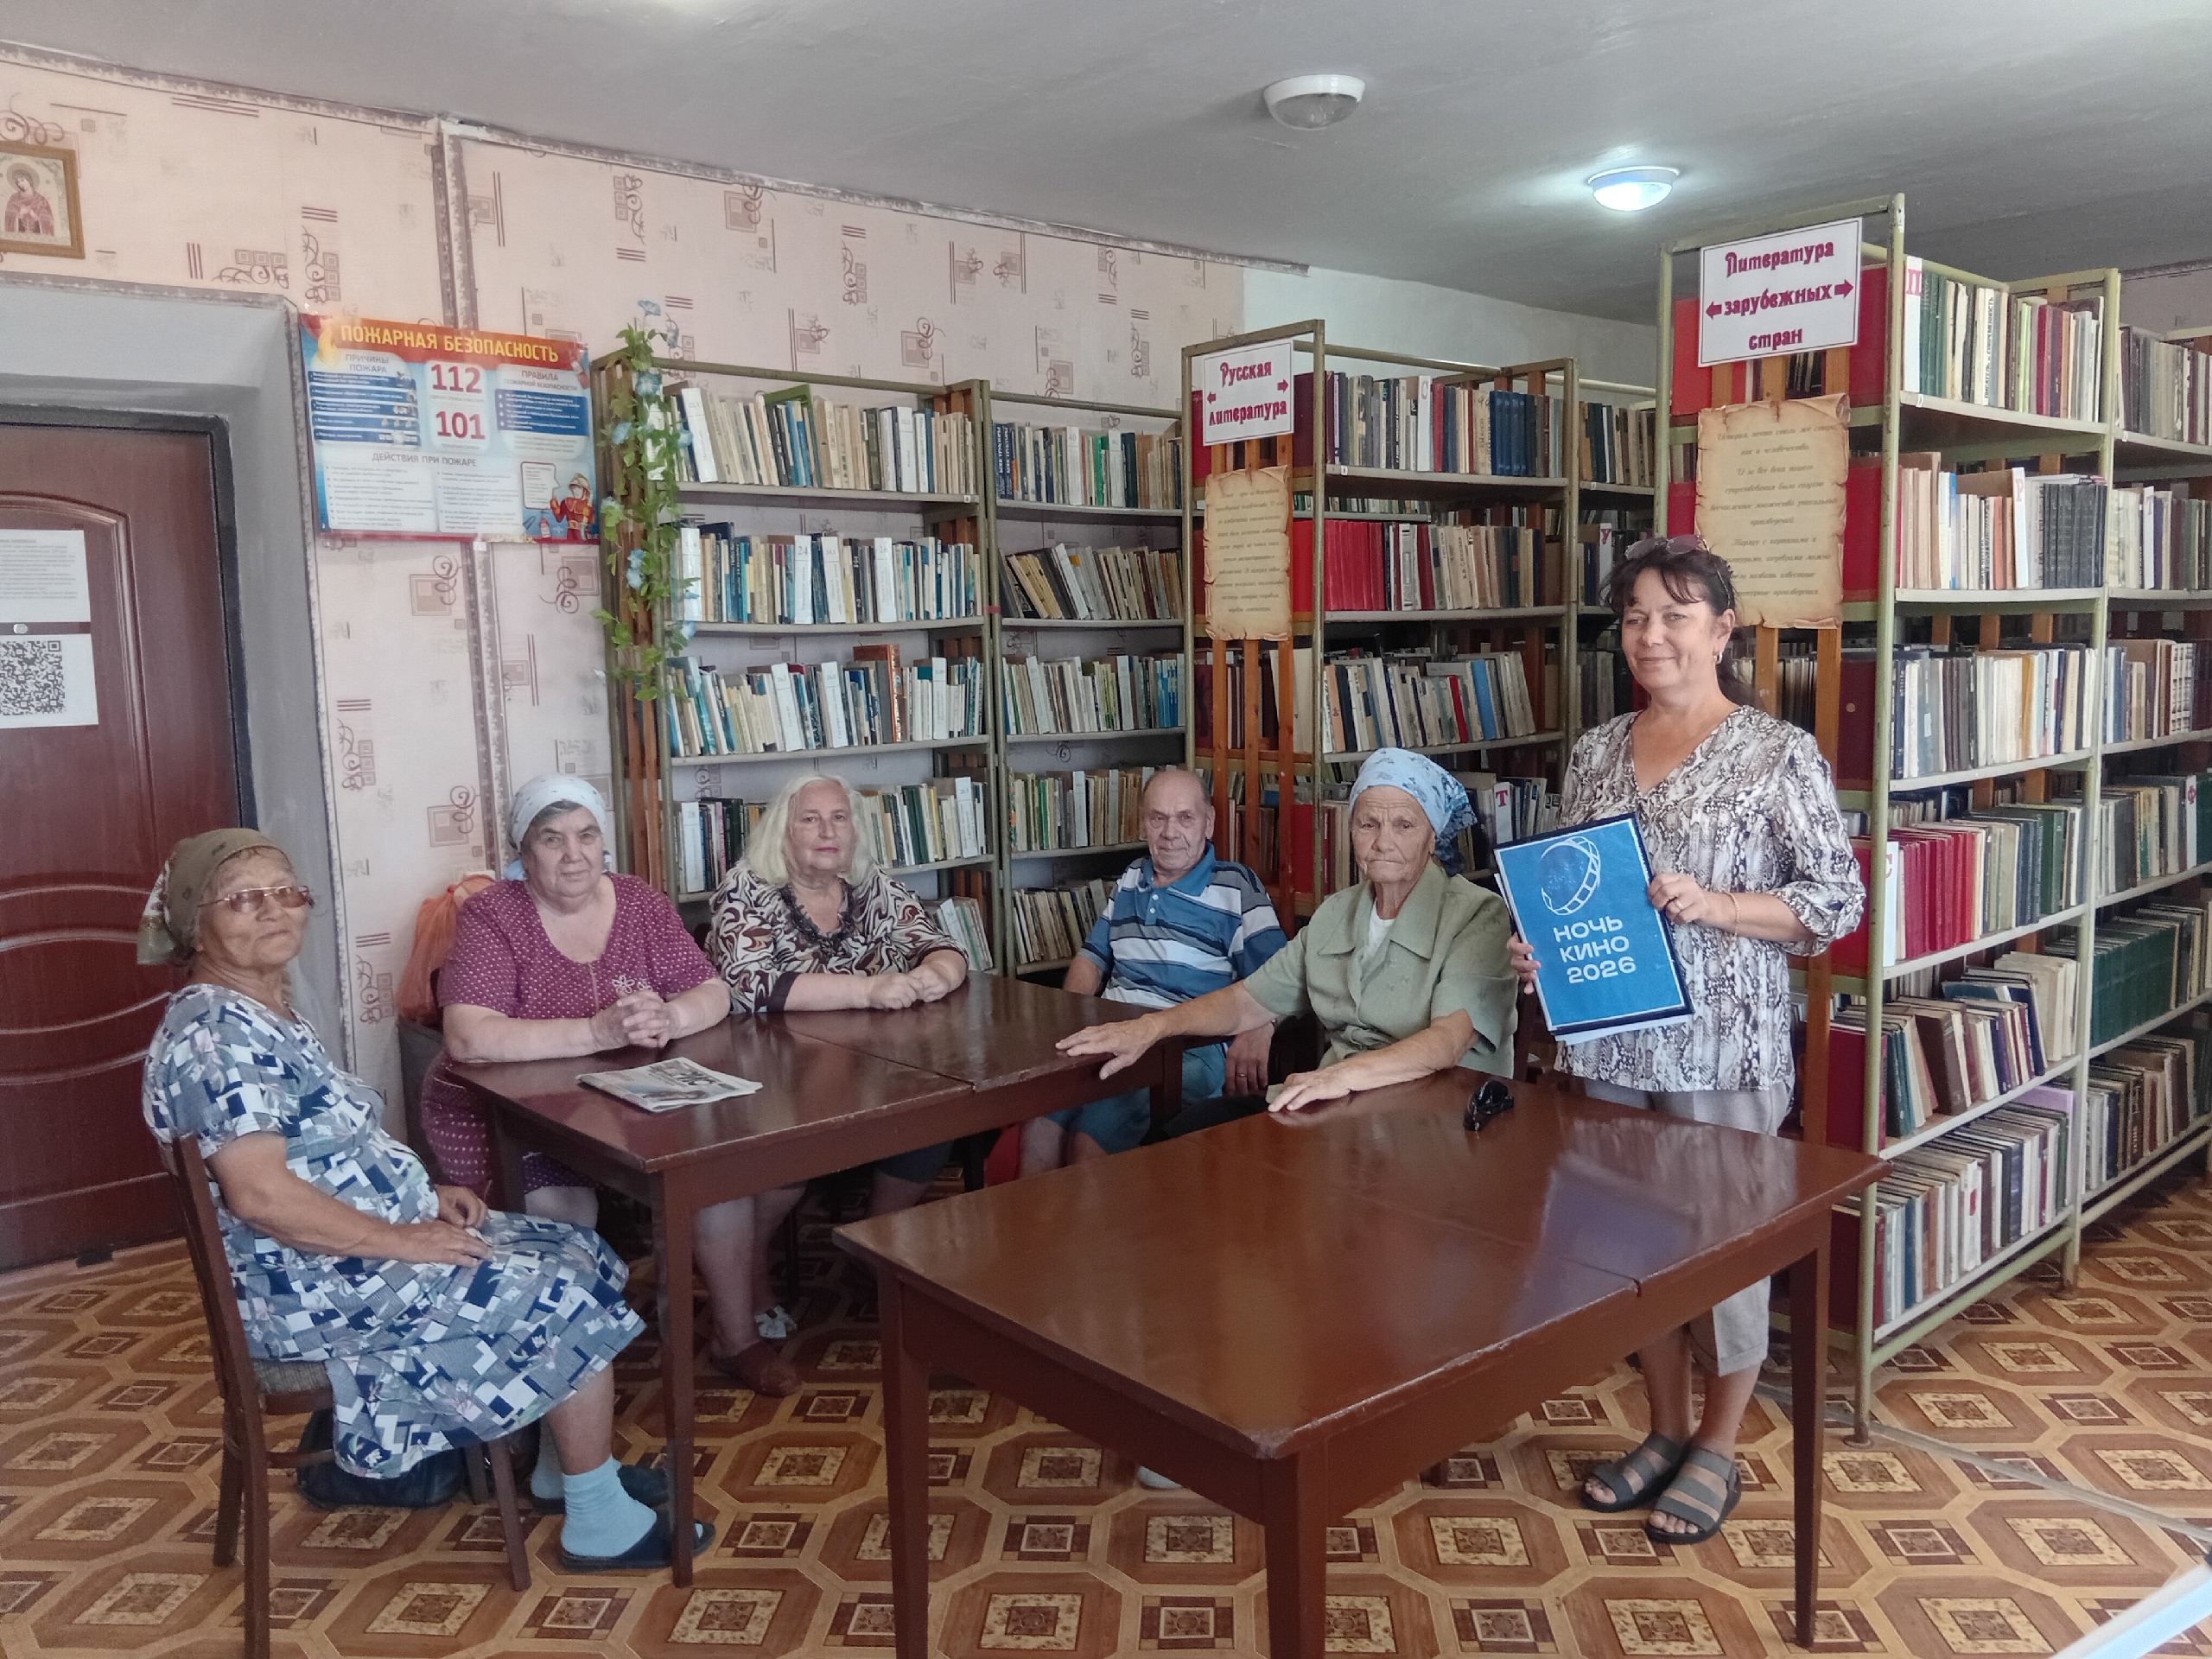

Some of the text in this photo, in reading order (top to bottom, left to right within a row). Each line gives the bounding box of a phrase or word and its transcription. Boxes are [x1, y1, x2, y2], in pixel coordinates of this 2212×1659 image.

[1725, 241, 1834, 278] Литература
[1724, 283, 1833, 316] зарубежных
[340, 324, 559, 363] ПОЖАРНАЯ БЕЗОПАСНОСТЬ
[1748, 328, 1802, 350] стран
[345, 353, 389, 364] ПРИЧИНЫ
[349, 364, 388, 373] ПОЖАРА
[430, 364, 483, 393] 112
[504, 378, 537, 388] ПОЖАРНОЙ
[521, 370, 559, 382] ПРАВИЛА
[1220, 361, 1272, 388] Русская
[435, 410, 486, 440] 101
[1209, 400, 1287, 426] литература
[372, 452, 478, 467] ДЕЙСТВИЯ ПРИ ПОЖАРЕ
[2016, 478, 2024, 501] Р
[798, 545, 810, 556] 24
[879, 545, 889, 554] 26
[1496, 791, 1510, 808] Т
[1553, 915, 1624, 943] НОЧЬ
[1559, 936, 1630, 963] КИНО
[1567, 956, 1637, 984] 2026
